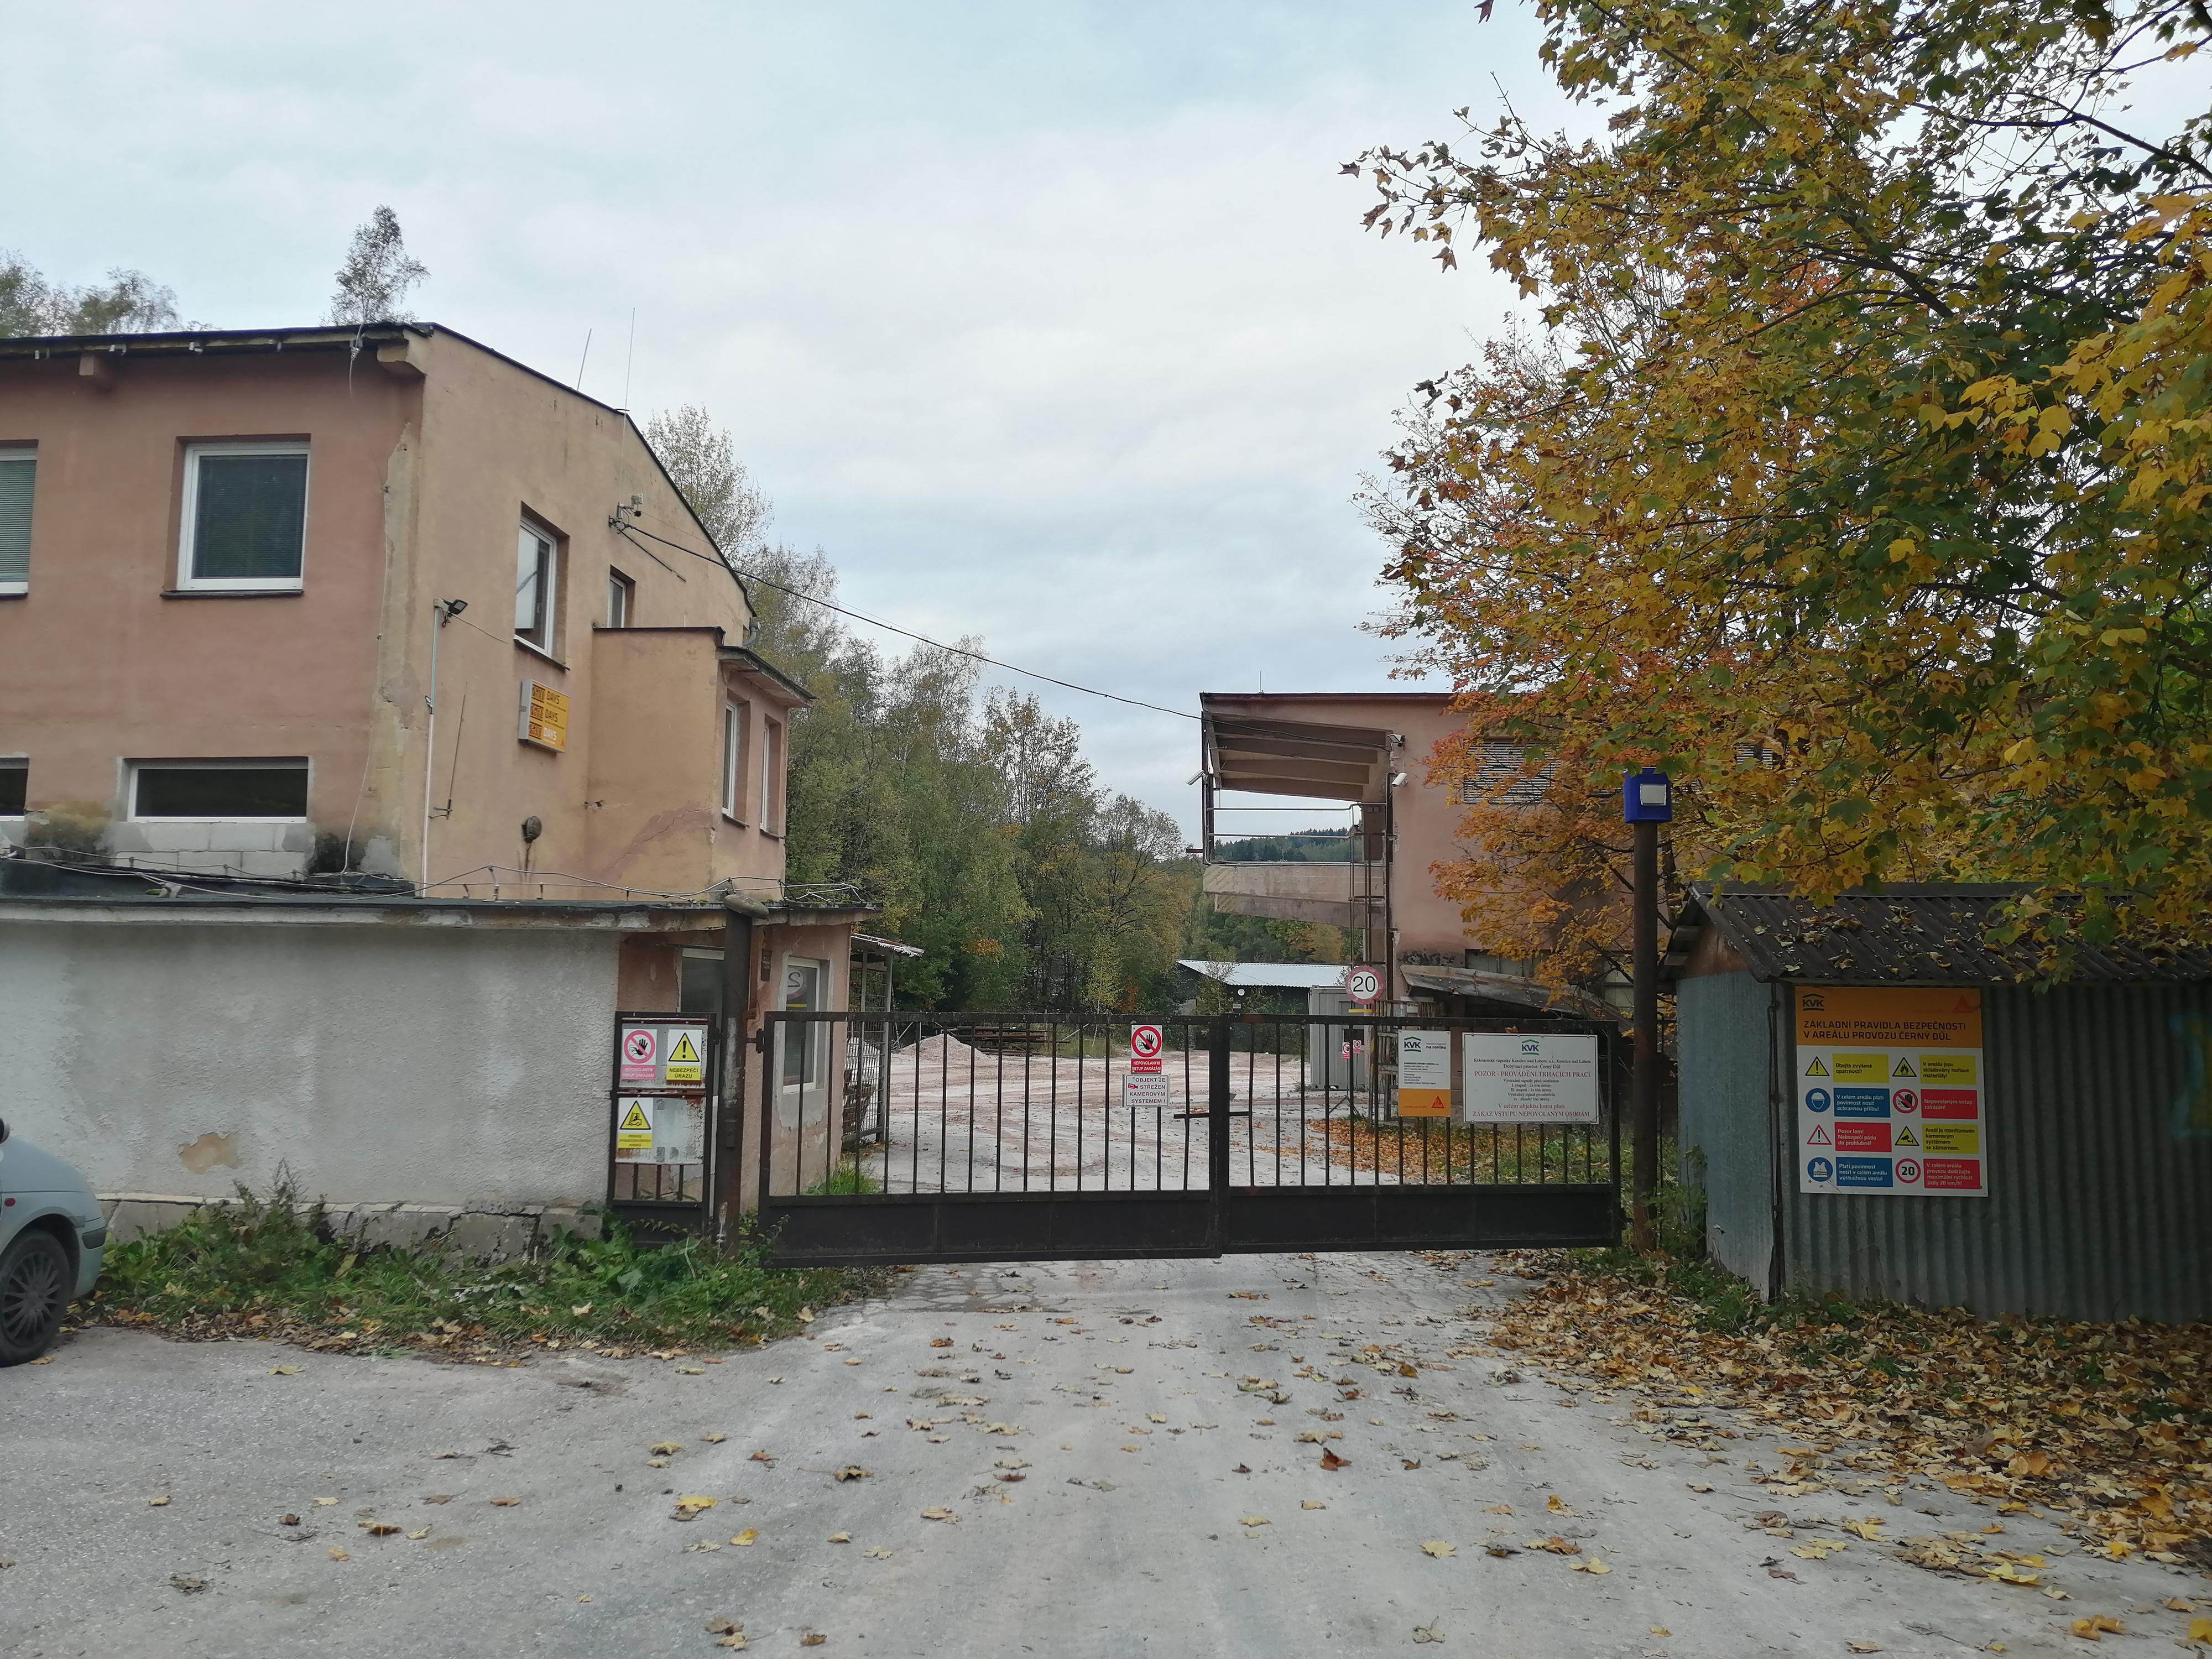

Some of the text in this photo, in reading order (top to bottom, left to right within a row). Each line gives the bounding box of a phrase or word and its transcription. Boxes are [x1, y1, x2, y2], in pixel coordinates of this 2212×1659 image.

[1353, 976, 1376, 992] 20
[1803, 1019, 1966, 1030] ZÁKLADNÍ PRAVIDLA BEZPEČNOSTI
[1812, 1030, 1850, 1039] AREÁLU
[1899, 1031, 1930, 1040] ČERNÝ
[1933, 1031, 1950, 1040] DŮL
[1901, 1166, 1915, 1176] 20
